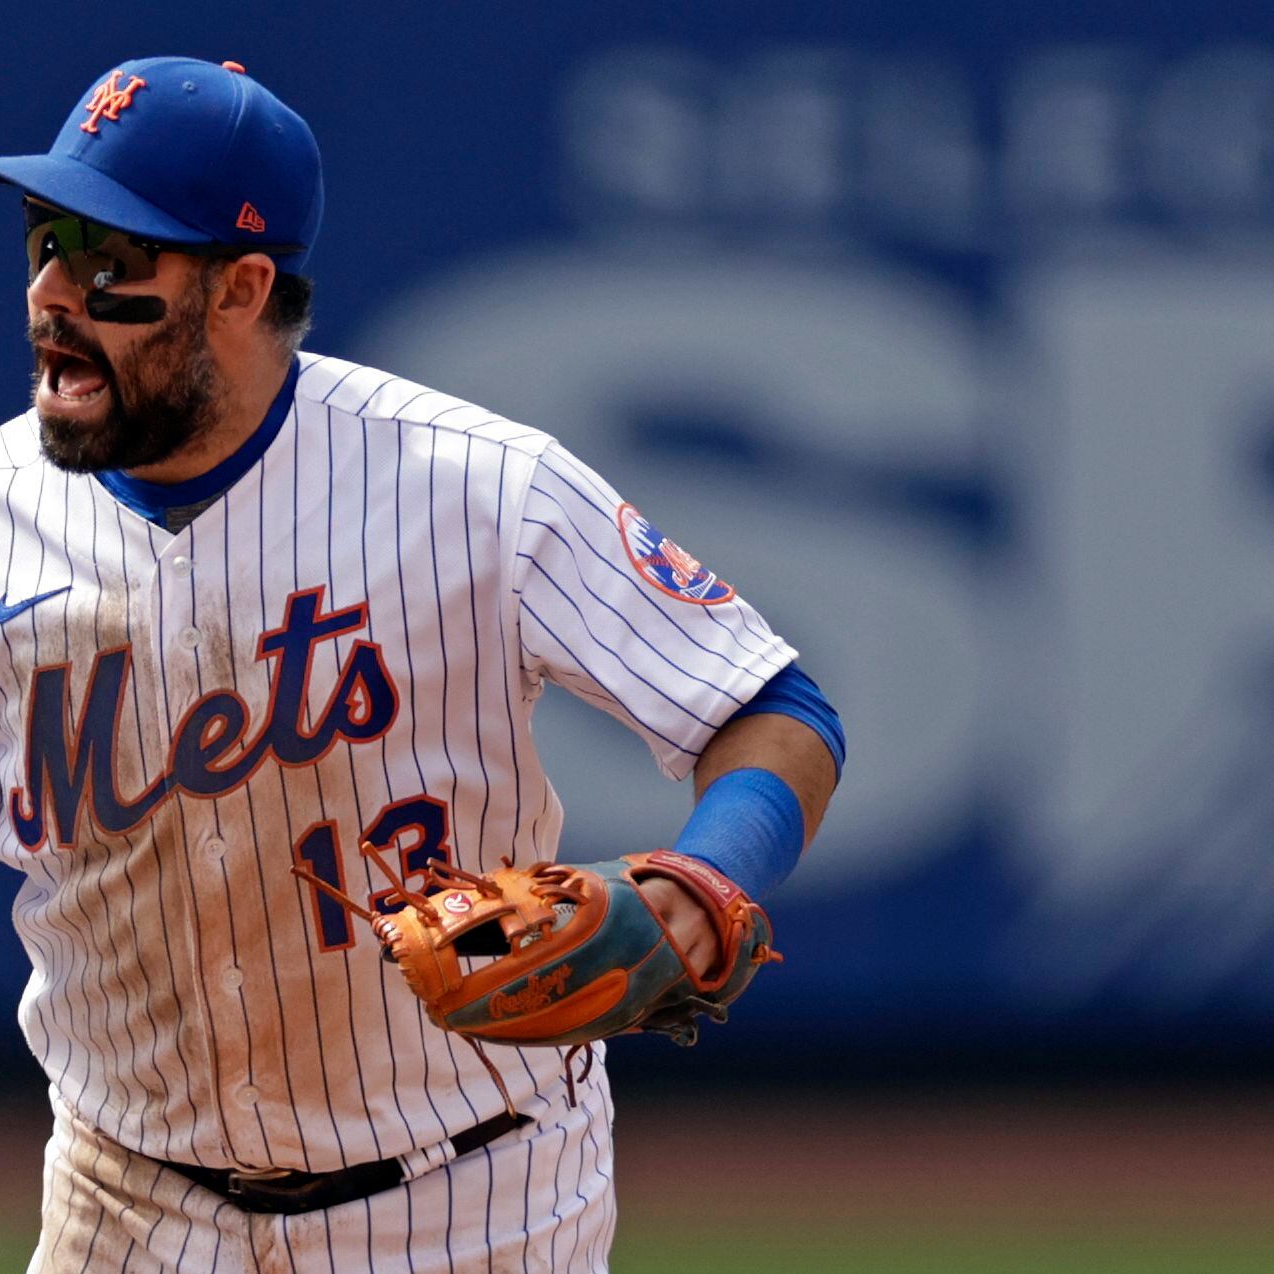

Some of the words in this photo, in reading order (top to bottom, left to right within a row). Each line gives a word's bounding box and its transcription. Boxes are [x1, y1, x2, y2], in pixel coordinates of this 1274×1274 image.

[79, 70, 146, 133] NY
[9, 583, 399, 853] Mets
[292, 794, 451, 954] 13
